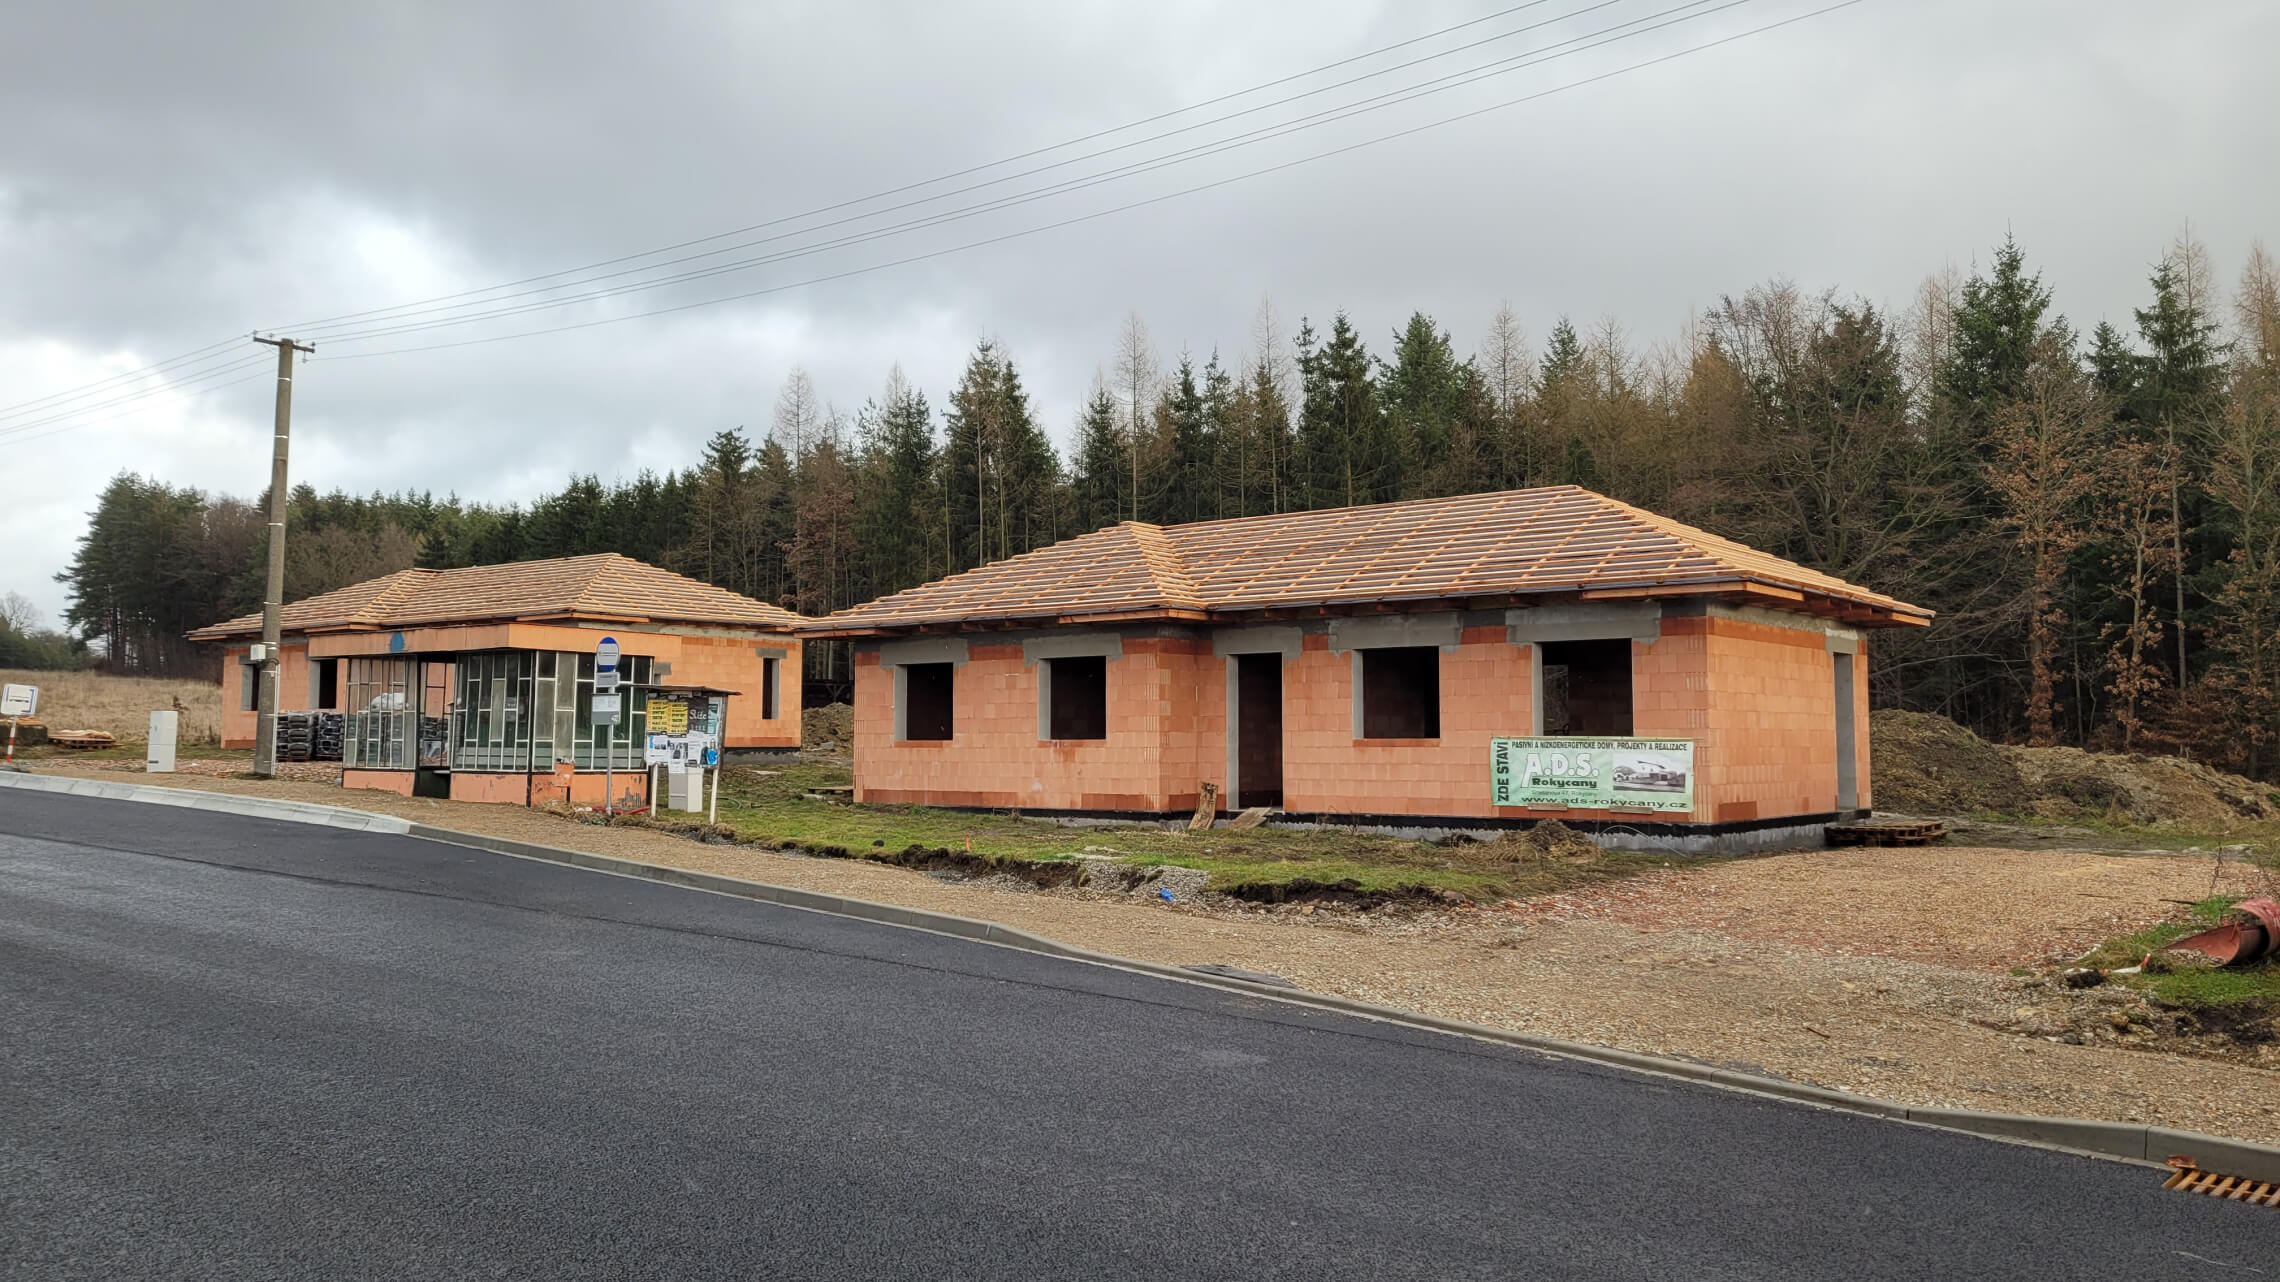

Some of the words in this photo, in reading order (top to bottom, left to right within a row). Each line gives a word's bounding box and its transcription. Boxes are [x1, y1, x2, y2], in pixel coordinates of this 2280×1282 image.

[1616, 742, 1647, 750] PROJEKTY
[1654, 743, 1687, 751] REALIZACE
[1520, 752, 1600, 788] A.D.S.
[1531, 777, 1597, 788] Rokycany
[1497, 778, 1509, 801] ZDE
[1521, 797, 1688, 808] www.ads-rokycany.cz
